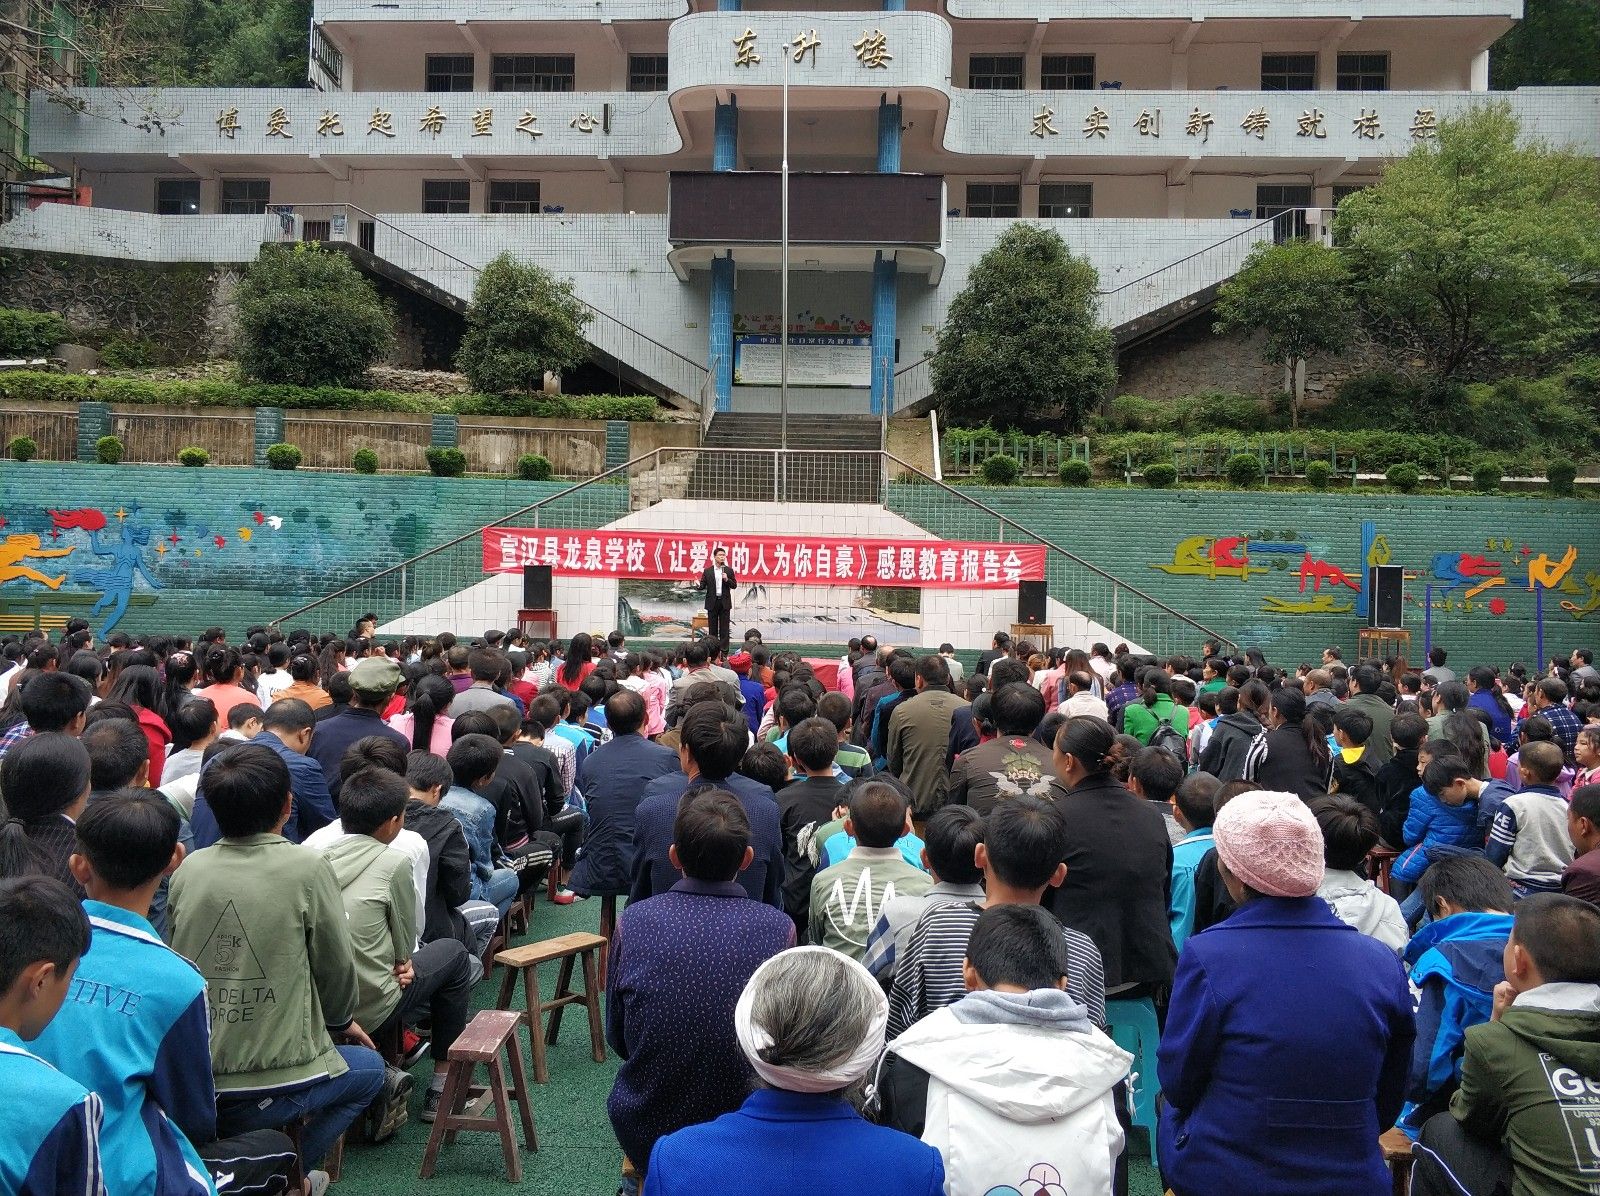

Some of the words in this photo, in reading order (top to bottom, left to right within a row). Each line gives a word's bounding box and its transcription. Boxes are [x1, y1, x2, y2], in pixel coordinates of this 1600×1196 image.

[733, 27, 893, 69] 东升楼
[216, 106, 599, 140] 博爱托起希望之心
[1030, 104, 1438, 143] 求实创新铸就栋梁
[218, 987, 276, 1005] DELTA
